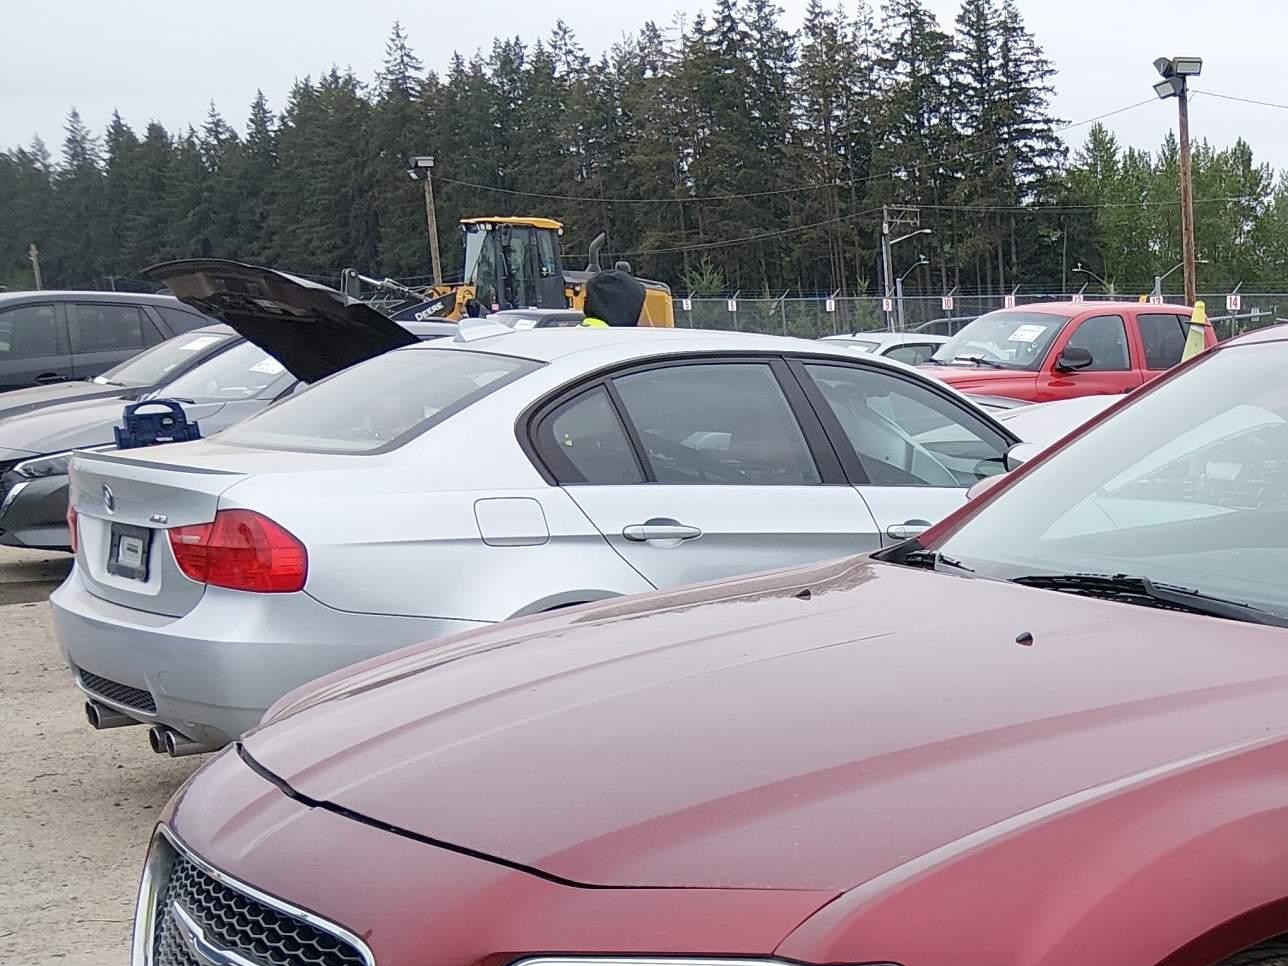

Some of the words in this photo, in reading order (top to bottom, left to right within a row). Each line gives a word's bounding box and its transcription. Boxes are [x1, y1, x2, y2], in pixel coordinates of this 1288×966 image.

[944, 297, 952, 309] 10
[1229, 296, 1238, 309] 14
[414, 301, 445, 321] DEERE
